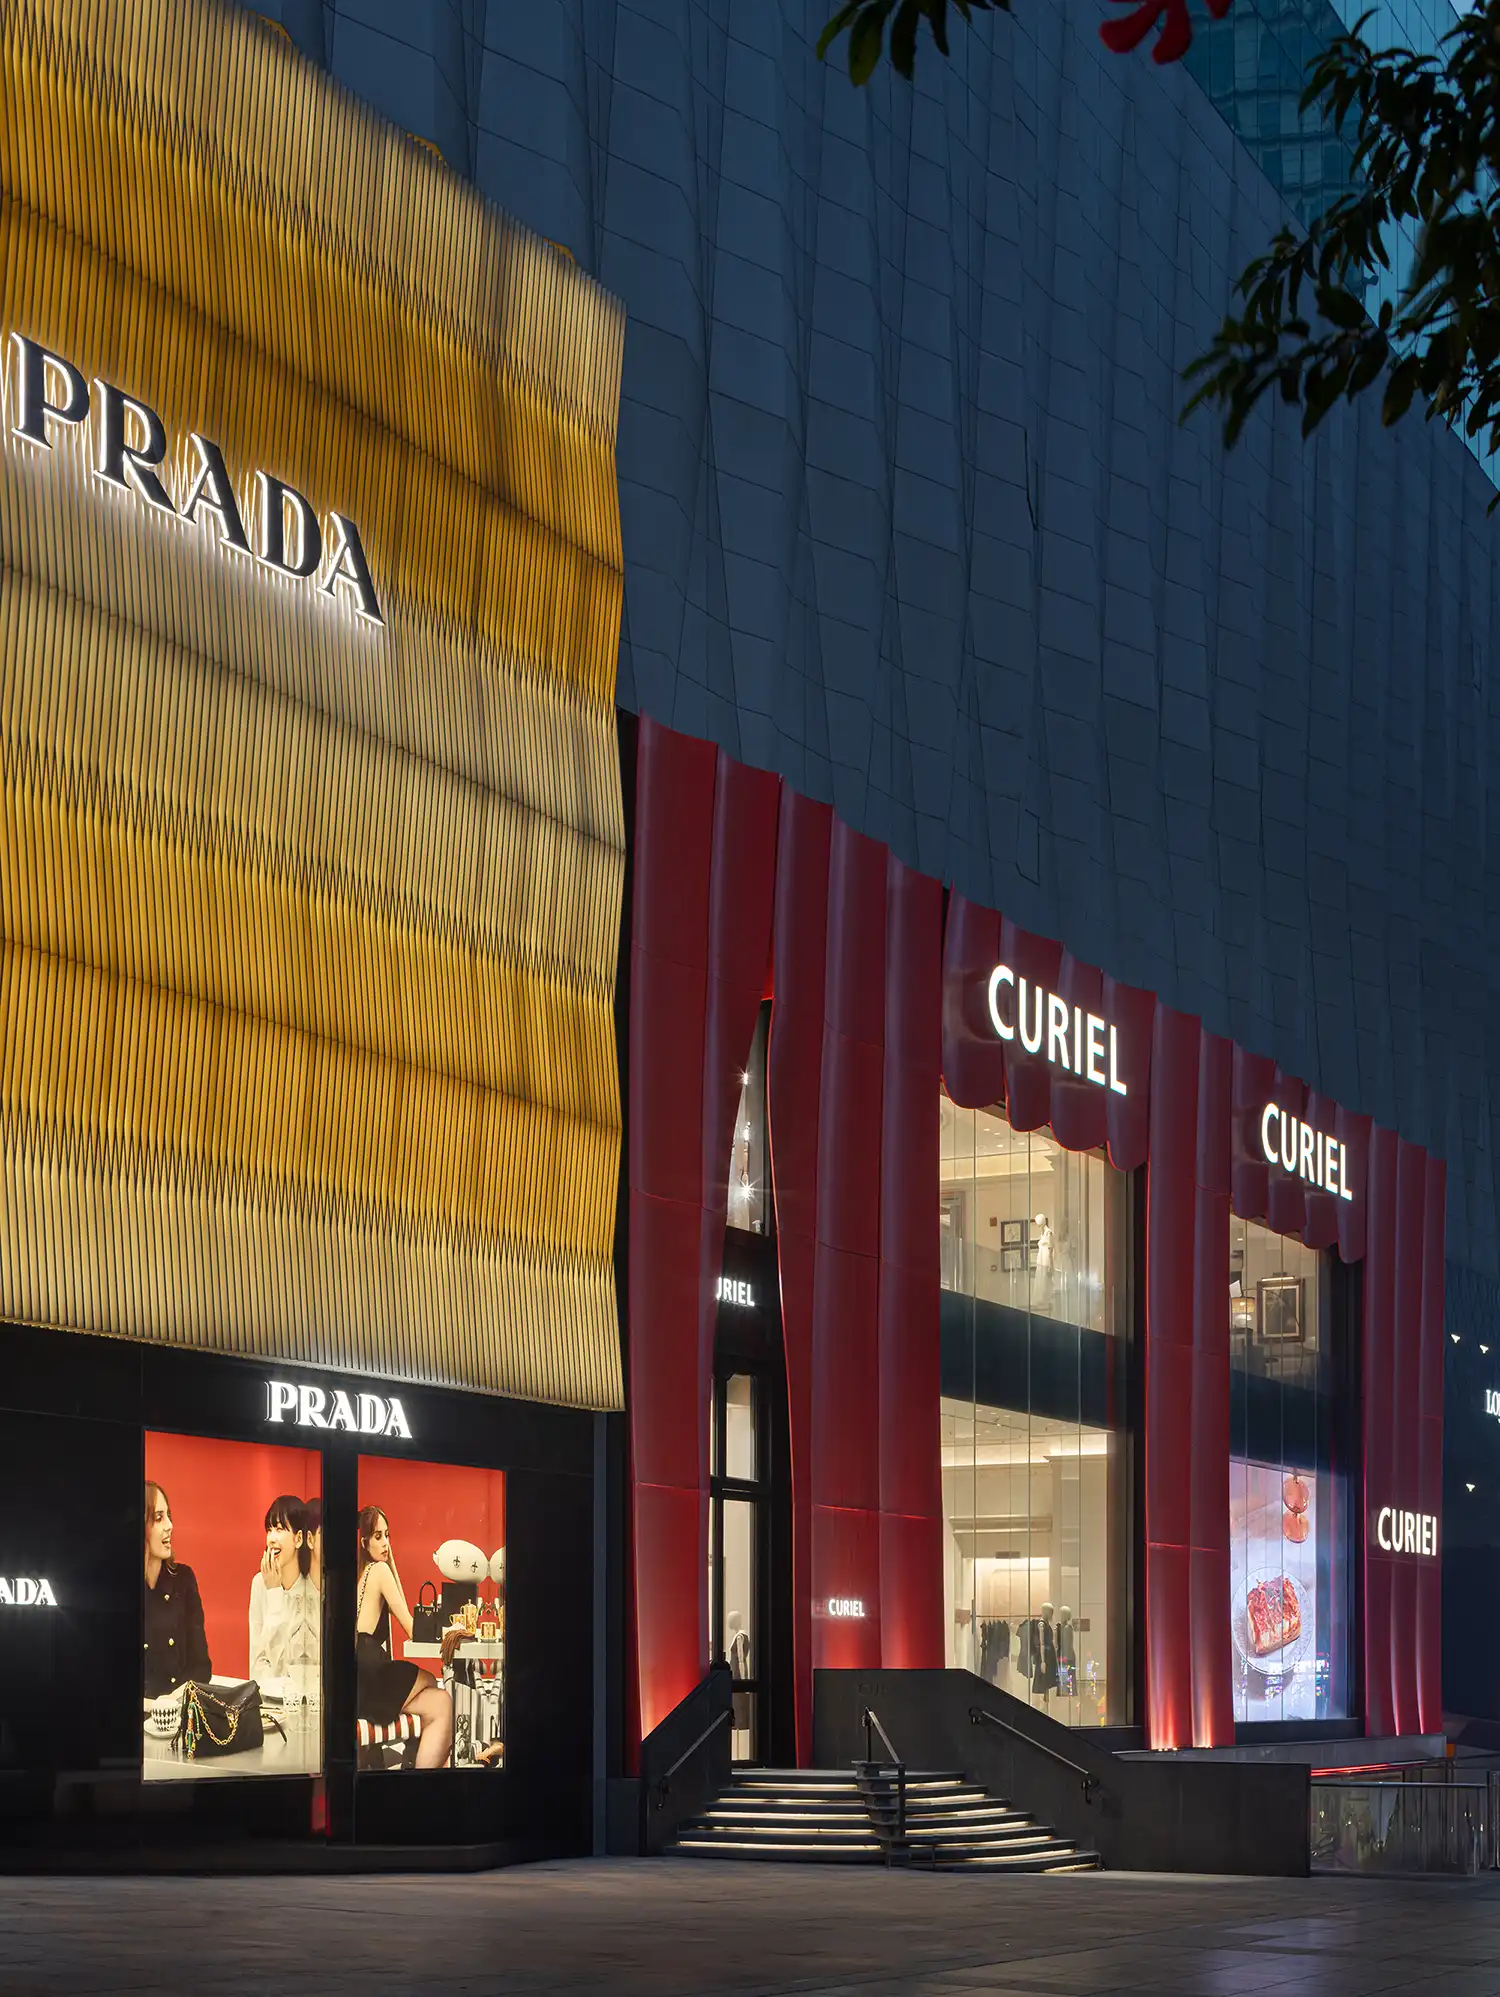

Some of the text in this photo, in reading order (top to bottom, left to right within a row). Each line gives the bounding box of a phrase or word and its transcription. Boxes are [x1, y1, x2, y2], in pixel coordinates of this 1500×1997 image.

[12, 331, 385, 626] PRADA
[988, 964, 1128, 1095] CURIEL
[1261, 1103, 1353, 1200] CURIEL
[264, 1380, 413, 1439] PRADA
[828, 1598, 866, 1617] CURIEL
